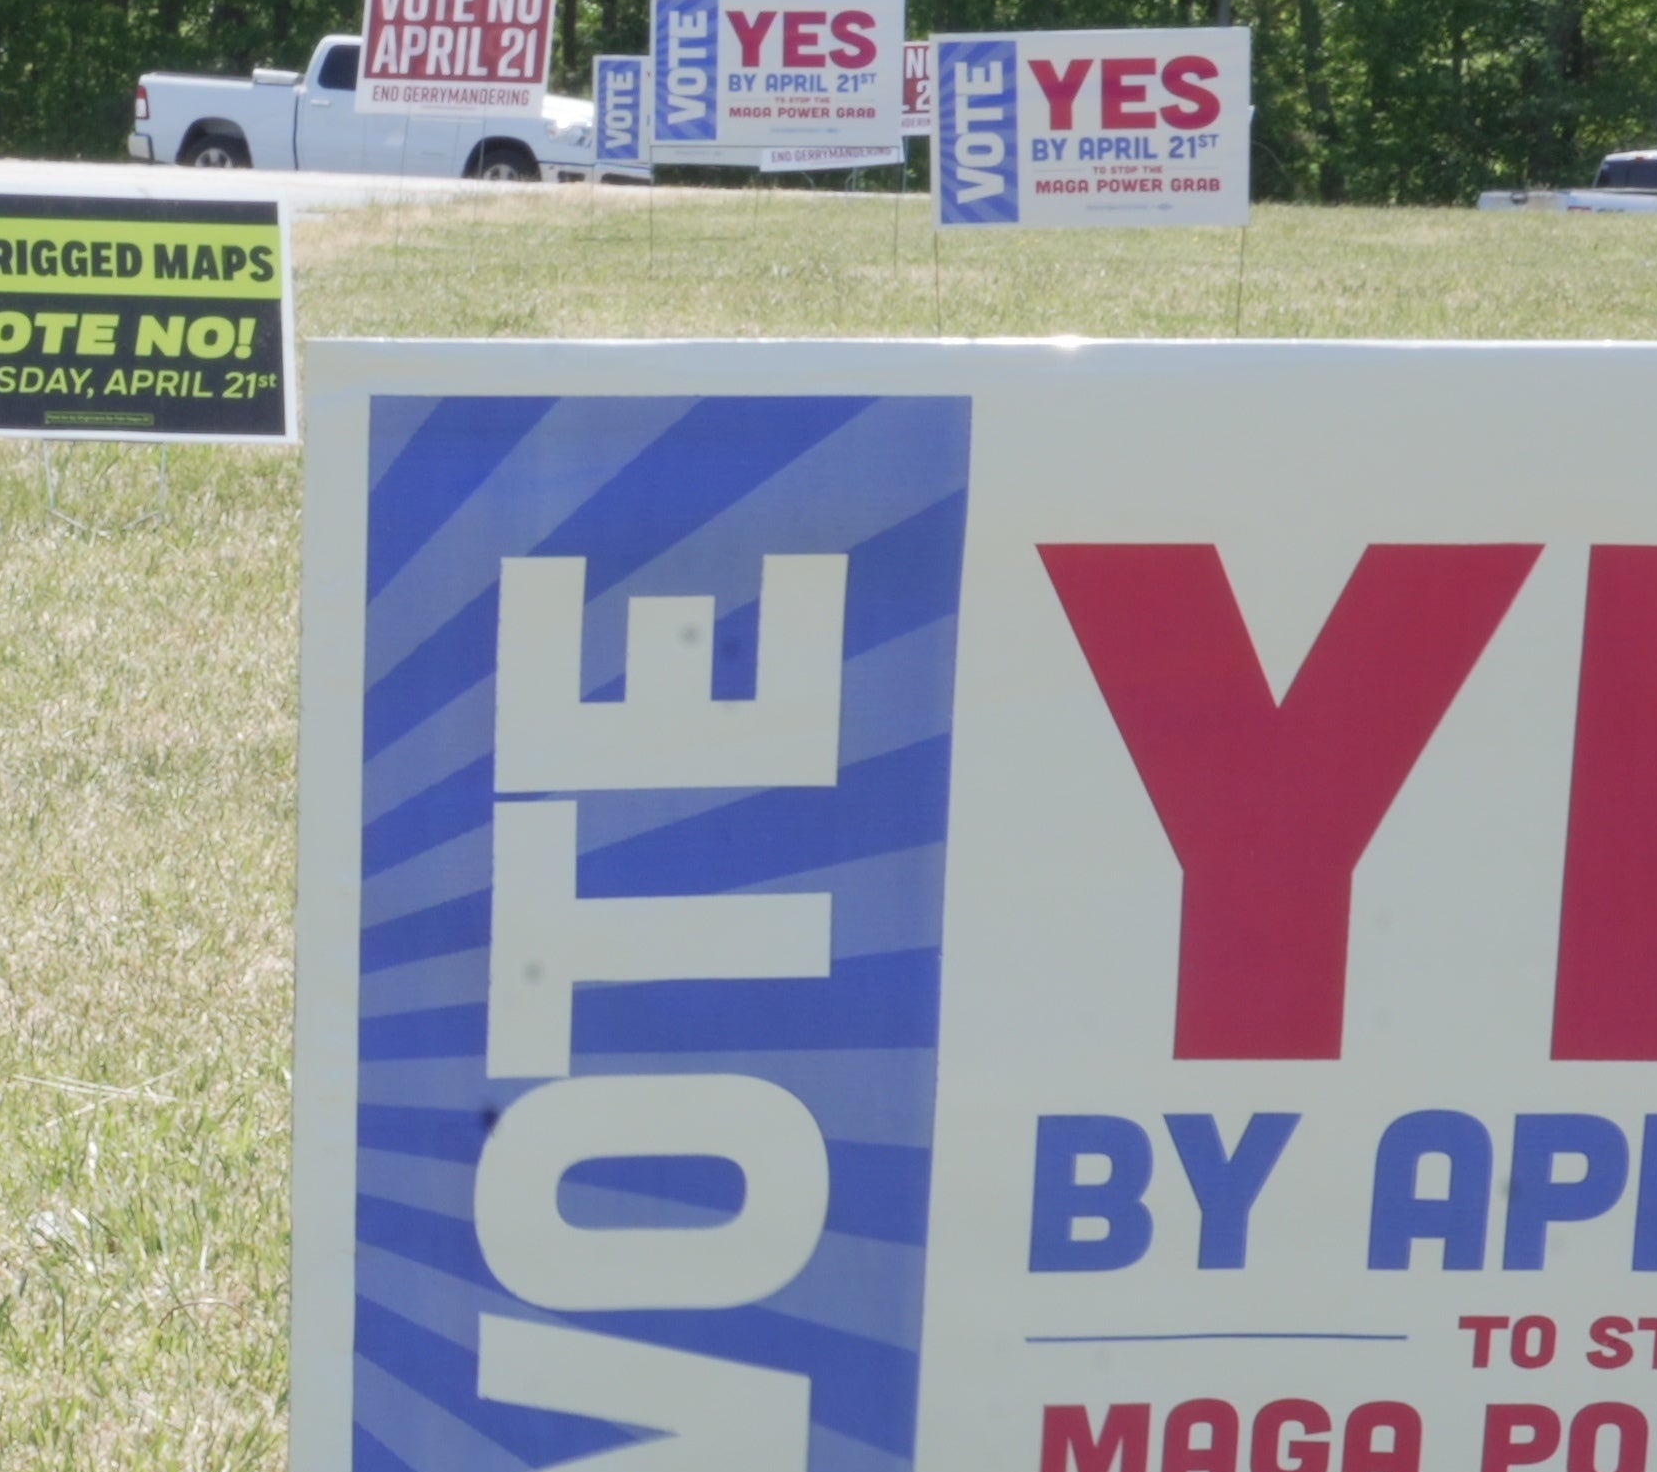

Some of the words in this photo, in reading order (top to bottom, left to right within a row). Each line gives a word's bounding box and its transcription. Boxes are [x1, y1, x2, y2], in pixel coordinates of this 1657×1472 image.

[371, 25, 487, 77] APRIL
[497, 28, 537, 77] 21
[725, 10, 877, 69] YES
[667, 10, 707, 125] VOTE
[906, 48, 929, 78] N
[372, 85, 399, 102] END
[403, 86, 530, 106] GERRYMANDERING
[728, 73, 754, 92] BY
[765, 73, 828, 92] APRIL
[836, 73, 877, 93] 21ST
[916, 80, 930, 111] 2
[1027, 55, 1221, 130] YES
[605, 71, 633, 148] VOTE
[729, 107, 774, 118] MAGA
[778, 107, 830, 118] POWER
[836, 107, 875, 118] GRAB
[955, 61, 1005, 204] VOTE
[1032, 138, 1068, 161] BY
[1078, 136, 1157, 160] APRIL
[1169, 134, 1219, 159] 21ST
[771, 150, 792, 162] END
[1093, 166, 1107, 174] TO
[1111, 166, 1138, 174] STOP
[1143, 165, 1163, 174] THE
[1036, 180, 1088, 194] MAGA
[1097, 179, 1162, 193] POWER
[1171, 178, 1220, 192] GRAB
[154, 243, 274, 281] MAPS
[135, 315, 256, 359] NO!
[103, 369, 213, 397] APRIL
[222, 372, 277, 399] 21st
[1026, 1110, 1302, 1274] BY
[1458, 1313, 1556, 1371] TO
